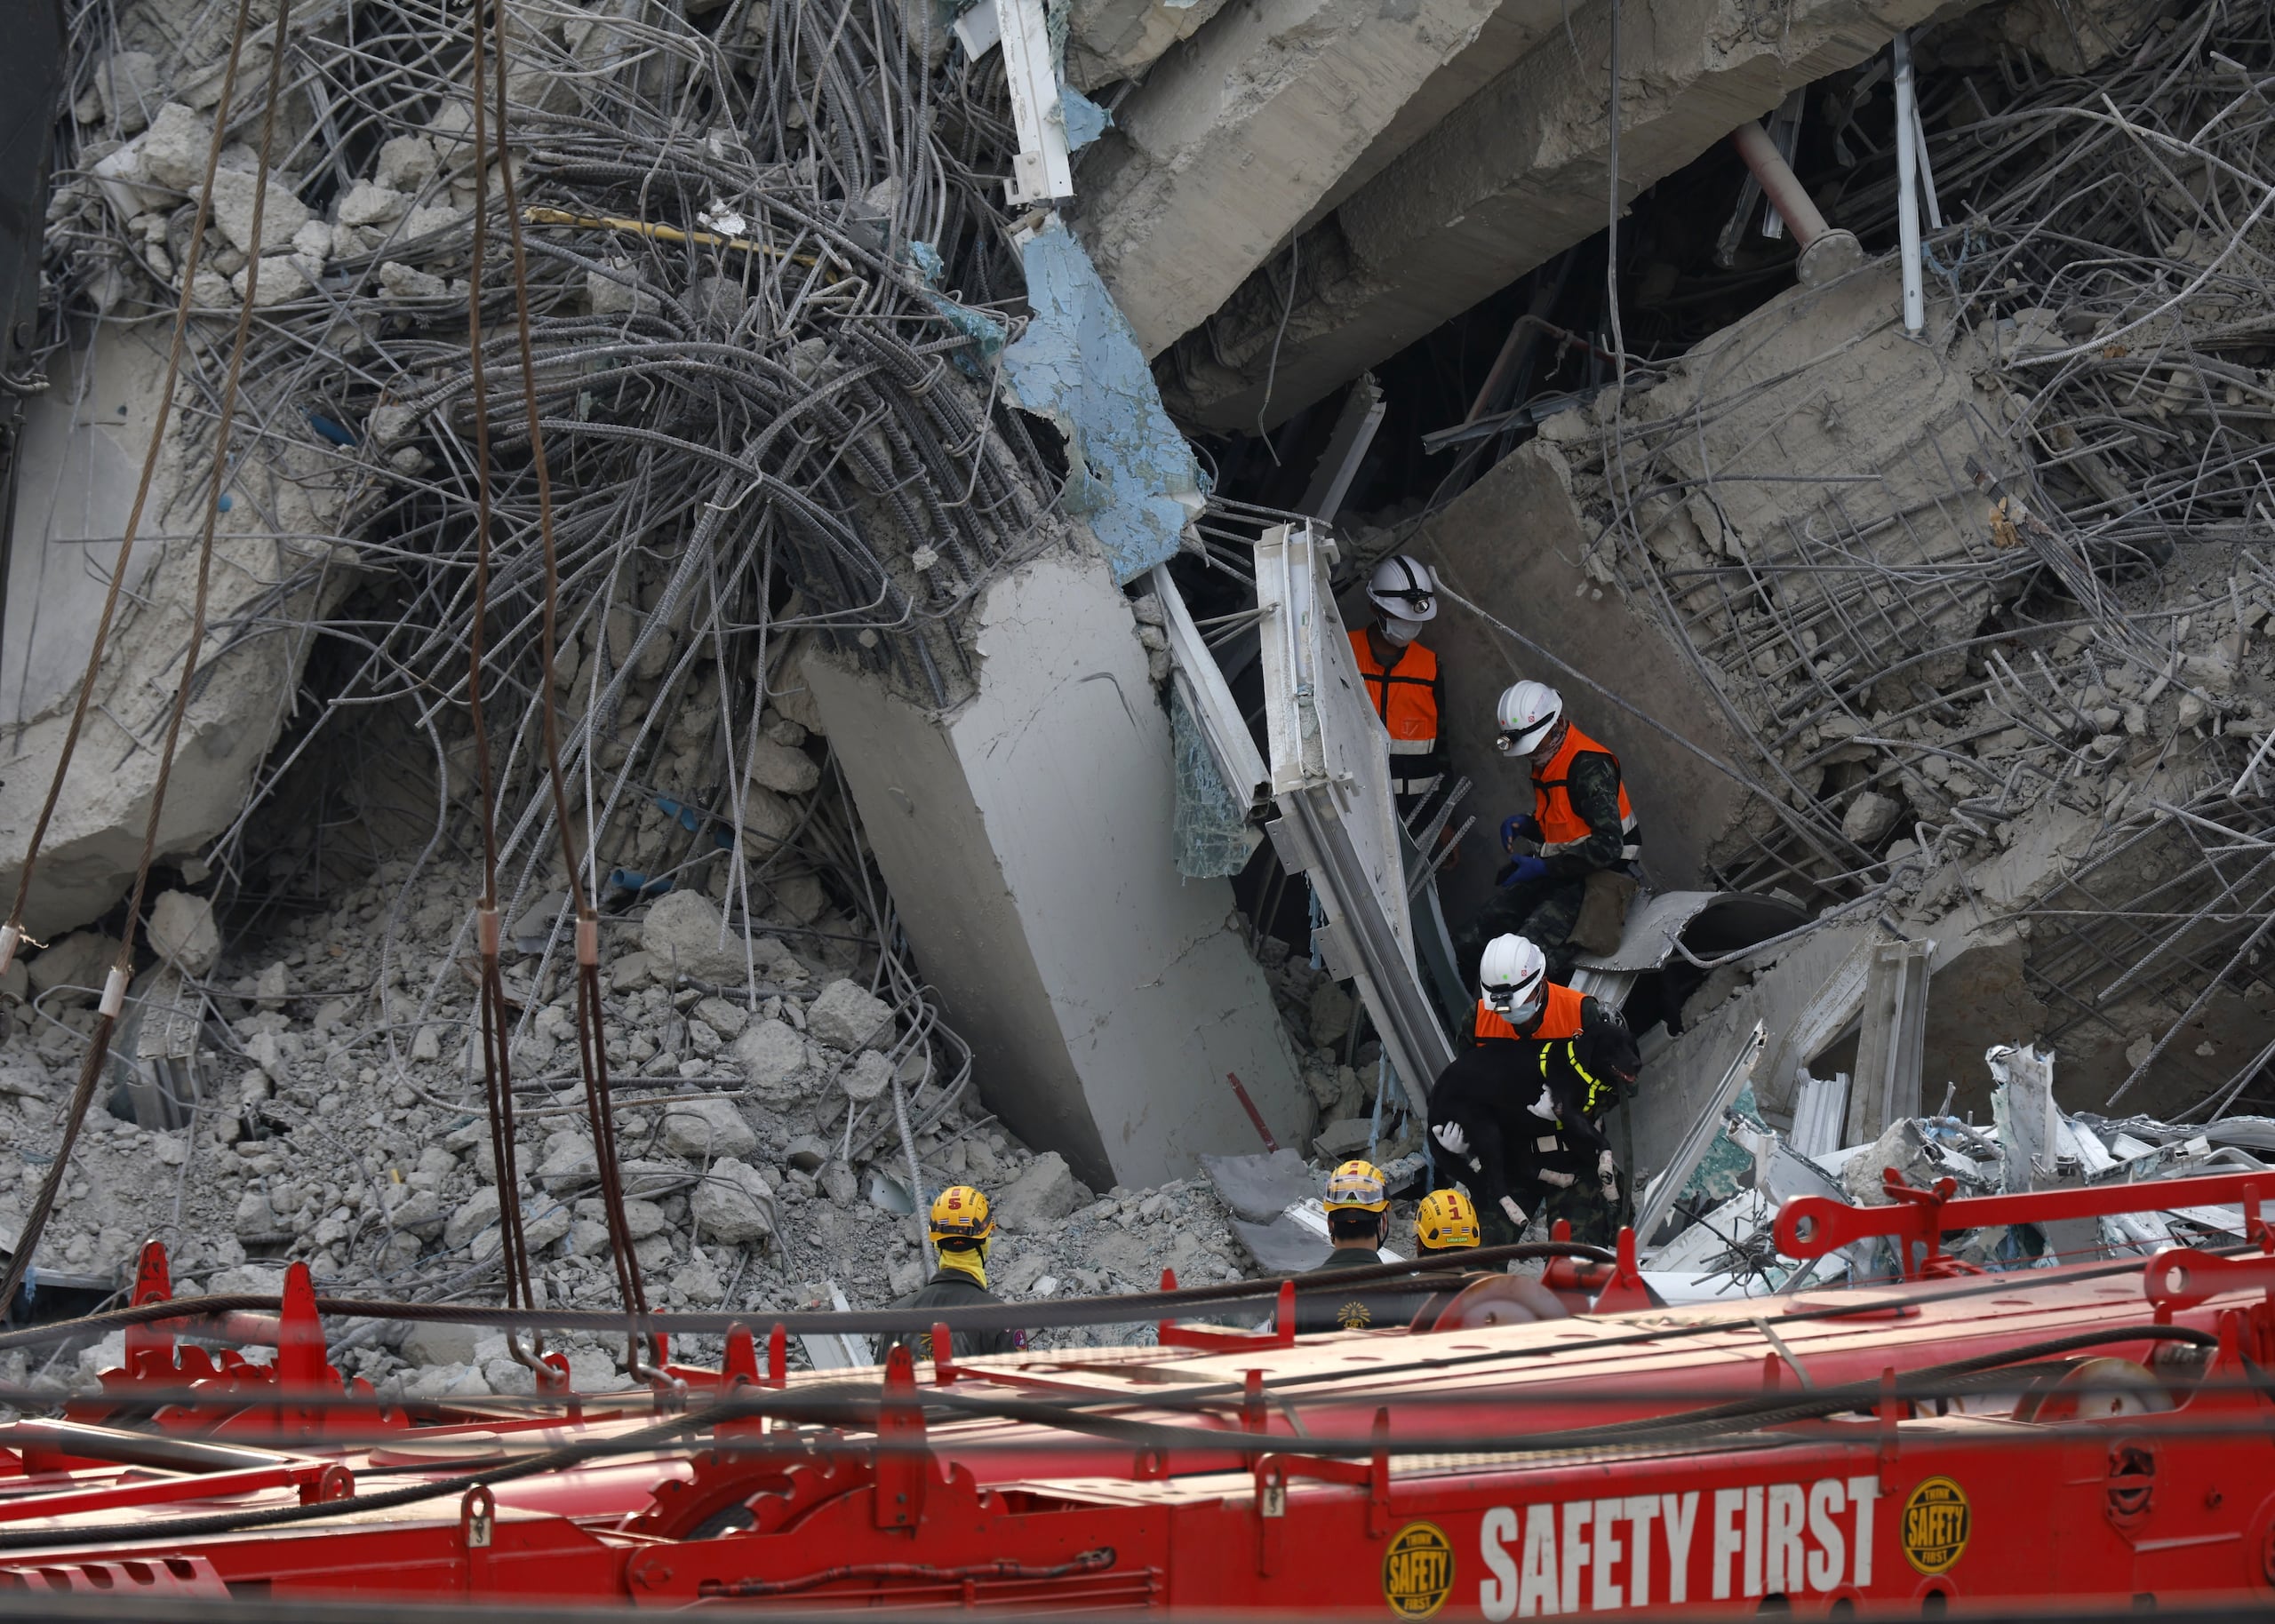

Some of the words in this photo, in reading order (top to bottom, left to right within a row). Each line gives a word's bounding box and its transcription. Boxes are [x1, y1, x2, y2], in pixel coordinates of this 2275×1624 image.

[948, 1198, 962, 1210] 5
[1449, 1207, 1463, 1220] 1
[1908, 1505, 1964, 1548] SAFETY
[1480, 1490, 1701, 1622] SAFETY
[1712, 1475, 1884, 1600] FIRST
[1922, 1549, 1948, 1564] FIRST
[1389, 1550, 1448, 1593] SAFETY
[1404, 1596, 1432, 1611] FIRST
